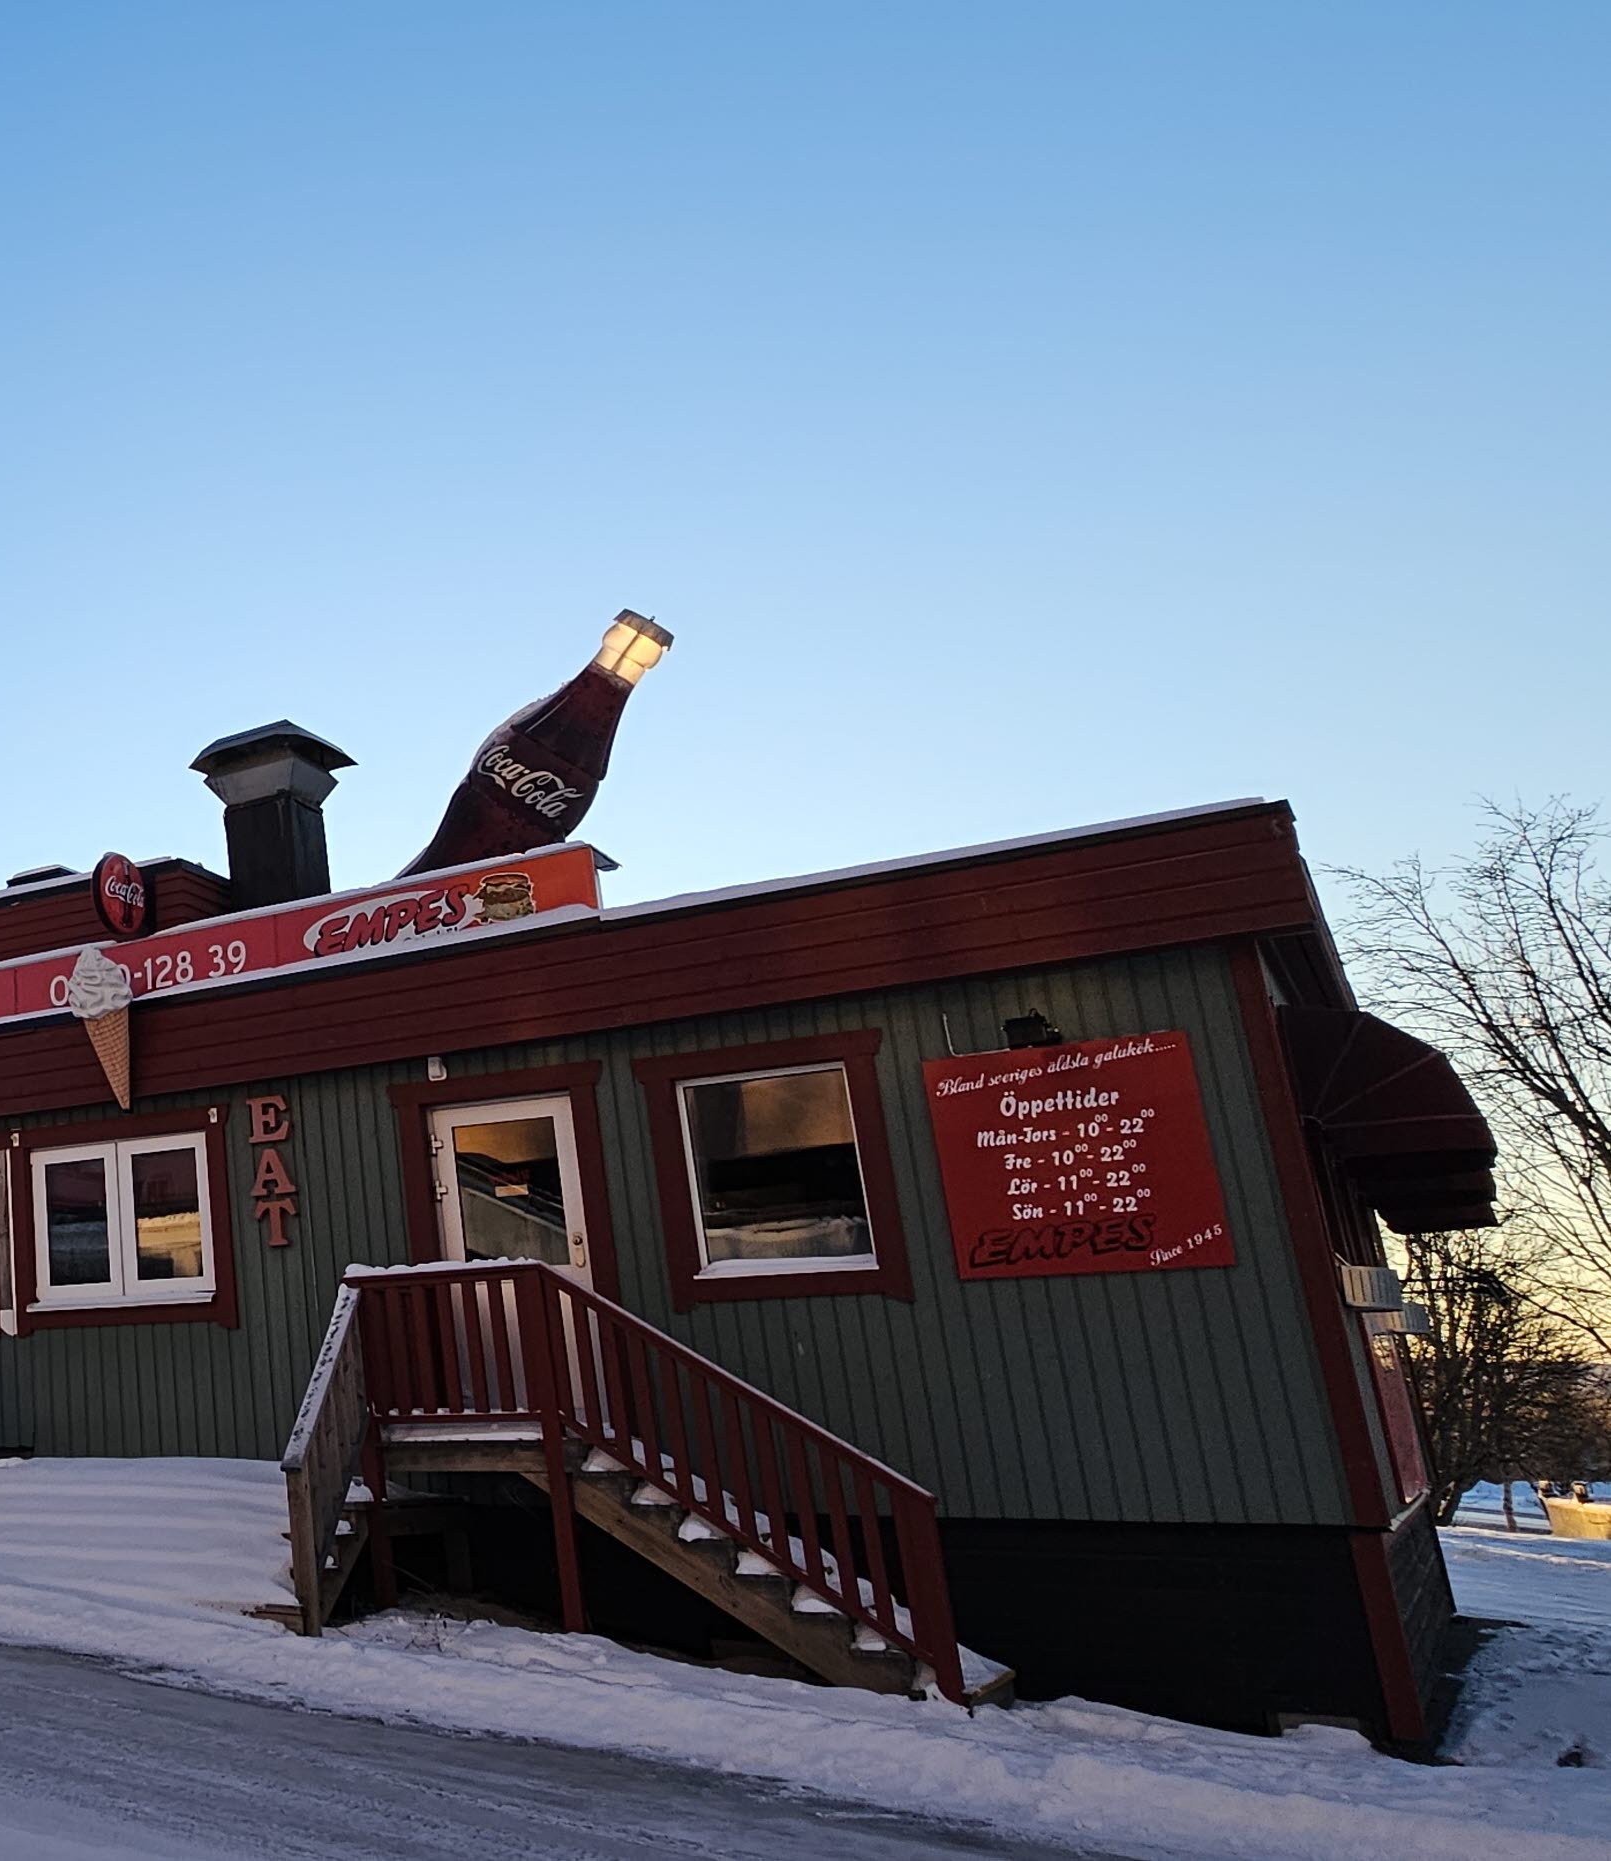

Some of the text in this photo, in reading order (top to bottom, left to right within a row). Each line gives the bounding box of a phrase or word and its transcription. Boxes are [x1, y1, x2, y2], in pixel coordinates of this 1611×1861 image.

[314, 884, 470, 957] EMPES
[208, 940, 247, 978] 39
[936, 1073, 985, 1097] Bland
[987, 1067, 1043, 1086] sveriges
[1000, 1086, 1119, 1120] Öppettider
[977, 1126, 1057, 1148] Mån-Tors
[246, 1095, 297, 1246] EAT
[1004, 1153, 1032, 1170] Fre
[1007, 1178, 1038, 1196] Lör
[1012, 1203, 1044, 1221] Sön
[969, 1212, 1156, 1269] EMPES
[1150, 1223, 1223, 1266] Since 1945
